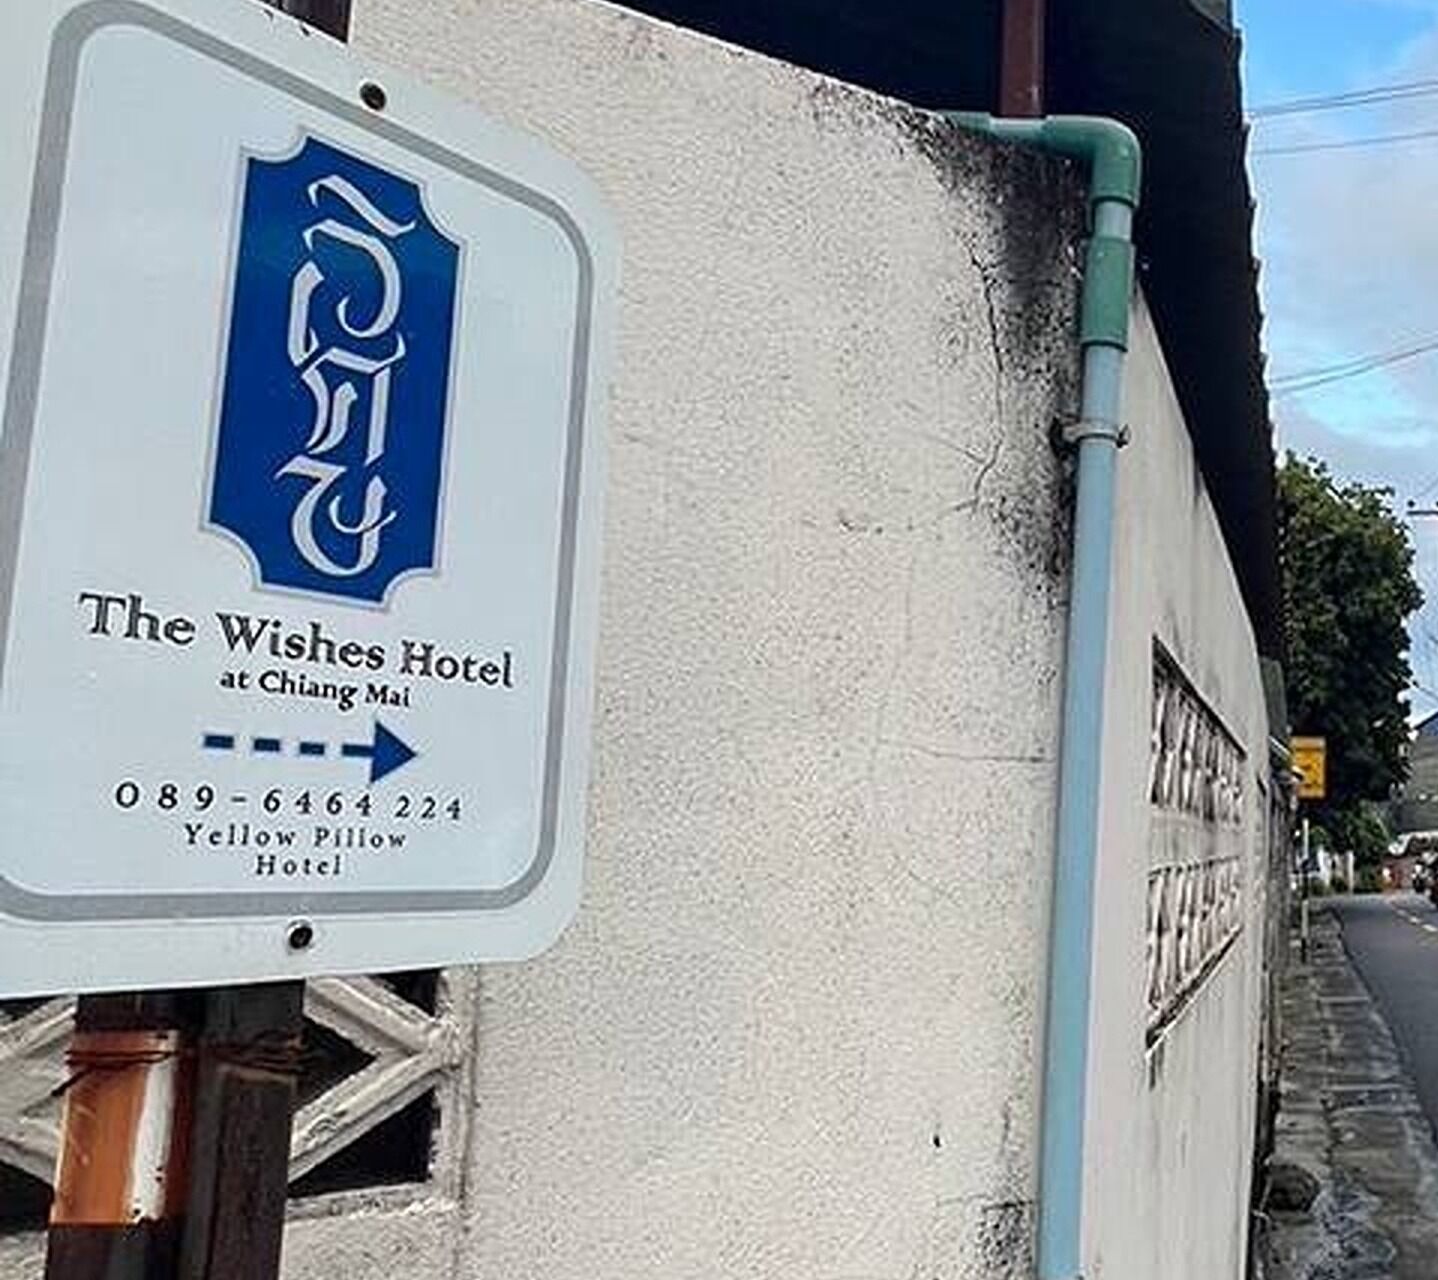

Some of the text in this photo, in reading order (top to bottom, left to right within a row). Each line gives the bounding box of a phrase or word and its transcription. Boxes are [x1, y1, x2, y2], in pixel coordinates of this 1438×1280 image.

[79, 593, 514, 688] The Wishes Hotel
[220, 671, 411, 711] at Chiang Mai
[185, 824, 407, 849] Yellow Pillow
[256, 854, 342, 876] Hotel
